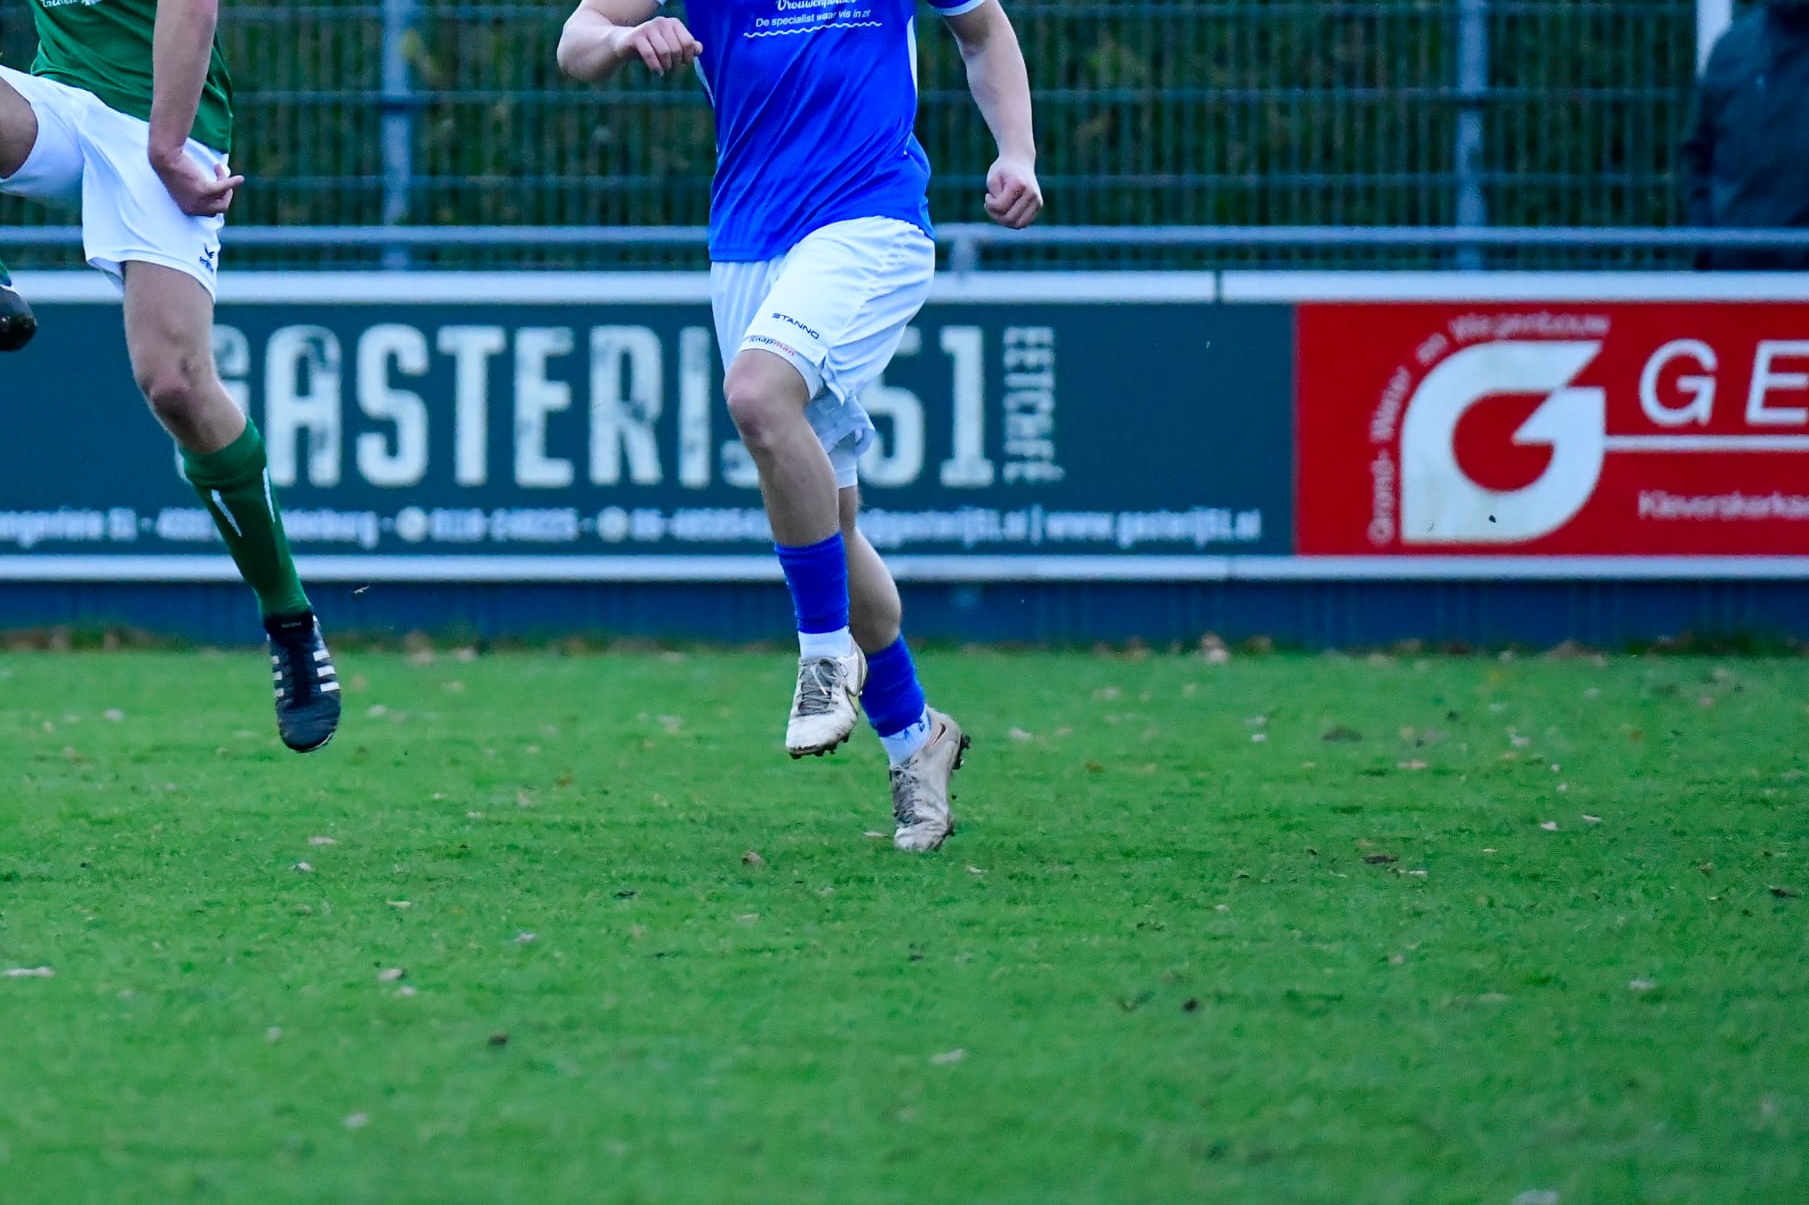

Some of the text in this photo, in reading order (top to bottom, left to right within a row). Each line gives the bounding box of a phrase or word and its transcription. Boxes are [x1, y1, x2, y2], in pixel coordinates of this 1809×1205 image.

[756, 18, 770, 27] De
[771, 9, 814, 27] specialist
[838, 9, 851, 19] vis
[772, 312, 820, 340] STANNO
